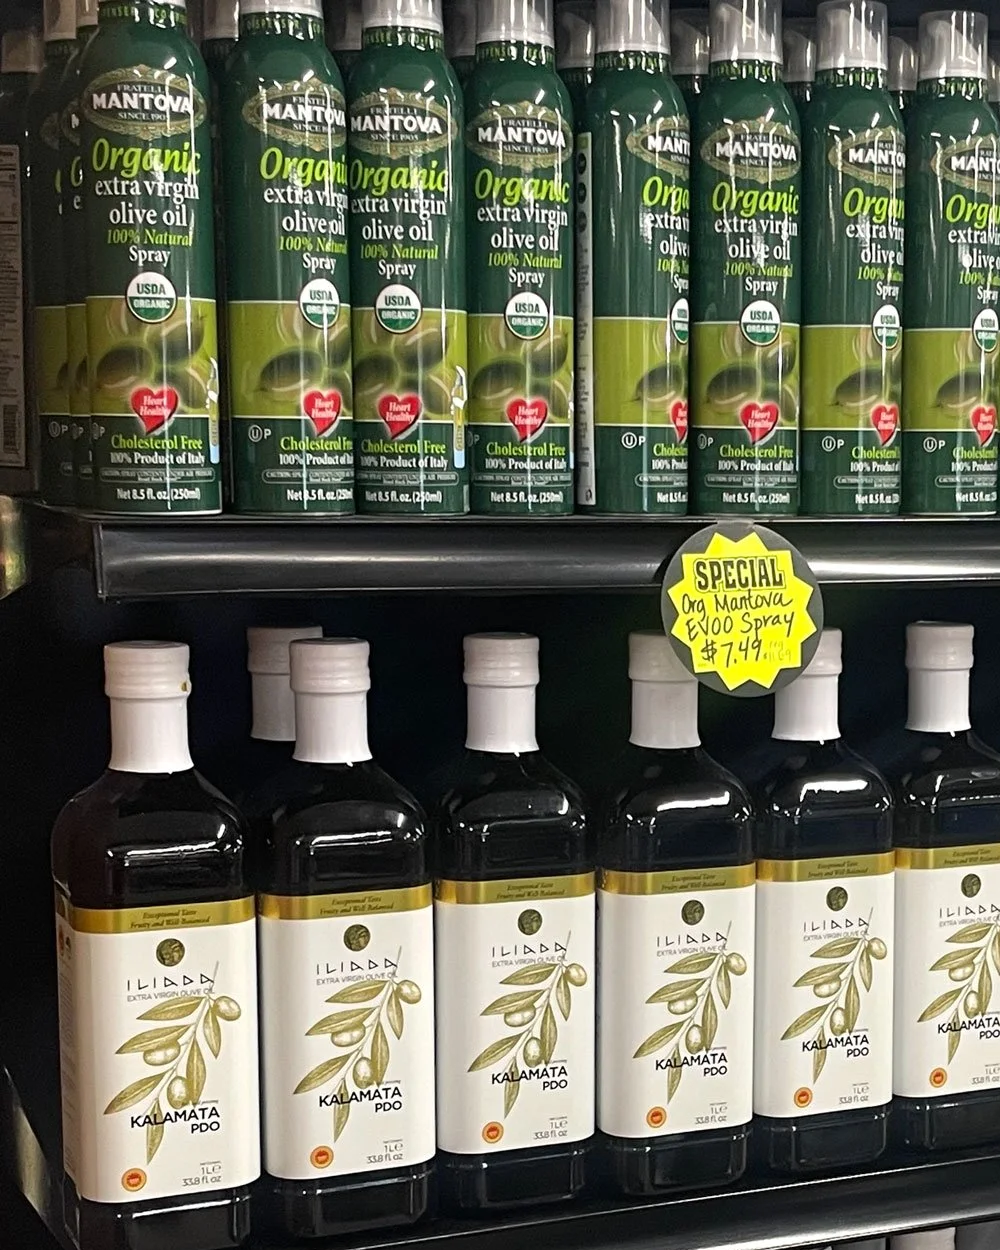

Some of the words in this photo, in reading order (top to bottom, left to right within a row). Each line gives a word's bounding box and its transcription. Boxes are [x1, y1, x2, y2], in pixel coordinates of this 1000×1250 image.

[93, 93, 191, 113] MANTOVA
[118, 112, 149, 120] SINCE
[351, 116, 442, 134] MANTOVA
[478, 127, 565, 147] MANTOVA
[92, 138, 201, 177] Organic
[716, 142, 797, 161] MANTOVA
[351, 160, 449, 196] Organic
[475, 169, 569, 205] Organic
[95, 177, 141, 196] extra
[148, 179, 200, 203] virgin
[352, 195, 390, 214] extra
[392, 196, 446, 219] virgin
[712, 182, 799, 218] Organic
[109, 202, 157, 224] olive
[163, 205, 187, 226] oil
[107, 229, 140, 243] 100%
[144, 230, 191, 246] Natural
[362, 219, 404, 240] olive
[409, 221, 433, 241] oil
[129, 246, 170, 266] Spray
[728, 241, 769, 259] olive
[774, 244, 790, 259] oil
[378, 260, 416, 279] Spray
[137, 283, 166, 295] USDA
[745, 277, 778, 295] Spray
[134, 299, 170, 309] ORGANIC
[385, 297, 411, 306] USDA
[144, 396, 167, 406] Heart
[111, 436, 178, 449] Cholesterol
[181, 438, 202, 449] Free
[134, 453, 173, 464] Product
[175, 453, 186, 463] of
[117, 489, 131, 499] Net
[133, 489, 147, 499] 8.5
[695, 558, 783, 591] SPECIAL
[682, 594, 705, 621] Org
[715, 589, 793, 612] Mantova
[686, 616, 732, 641] EVOO
[741, 612, 794, 639] Spray
[701, 637, 762, 668] $7.49
[804, 918, 869, 932] ILIADA
[492, 941, 568, 957] ILIADA
[316, 957, 398, 975] ILIADA
[127, 973, 214, 991] ILIADA
[127, 994, 152, 1002] EXTRA
[154, 991, 178, 999] VIRGIN
[802, 1035, 869, 1052] KALAMATA
[847, 1048, 869, 1057] PDO
[492, 1067, 568, 1085] KALAMATA
[320, 1086, 402, 1106] KALAMATA
[375, 1101, 402, 1112] PDO
[131, 1106, 220, 1128] KALAMATA
[191, 1121, 220, 1132] PDO
